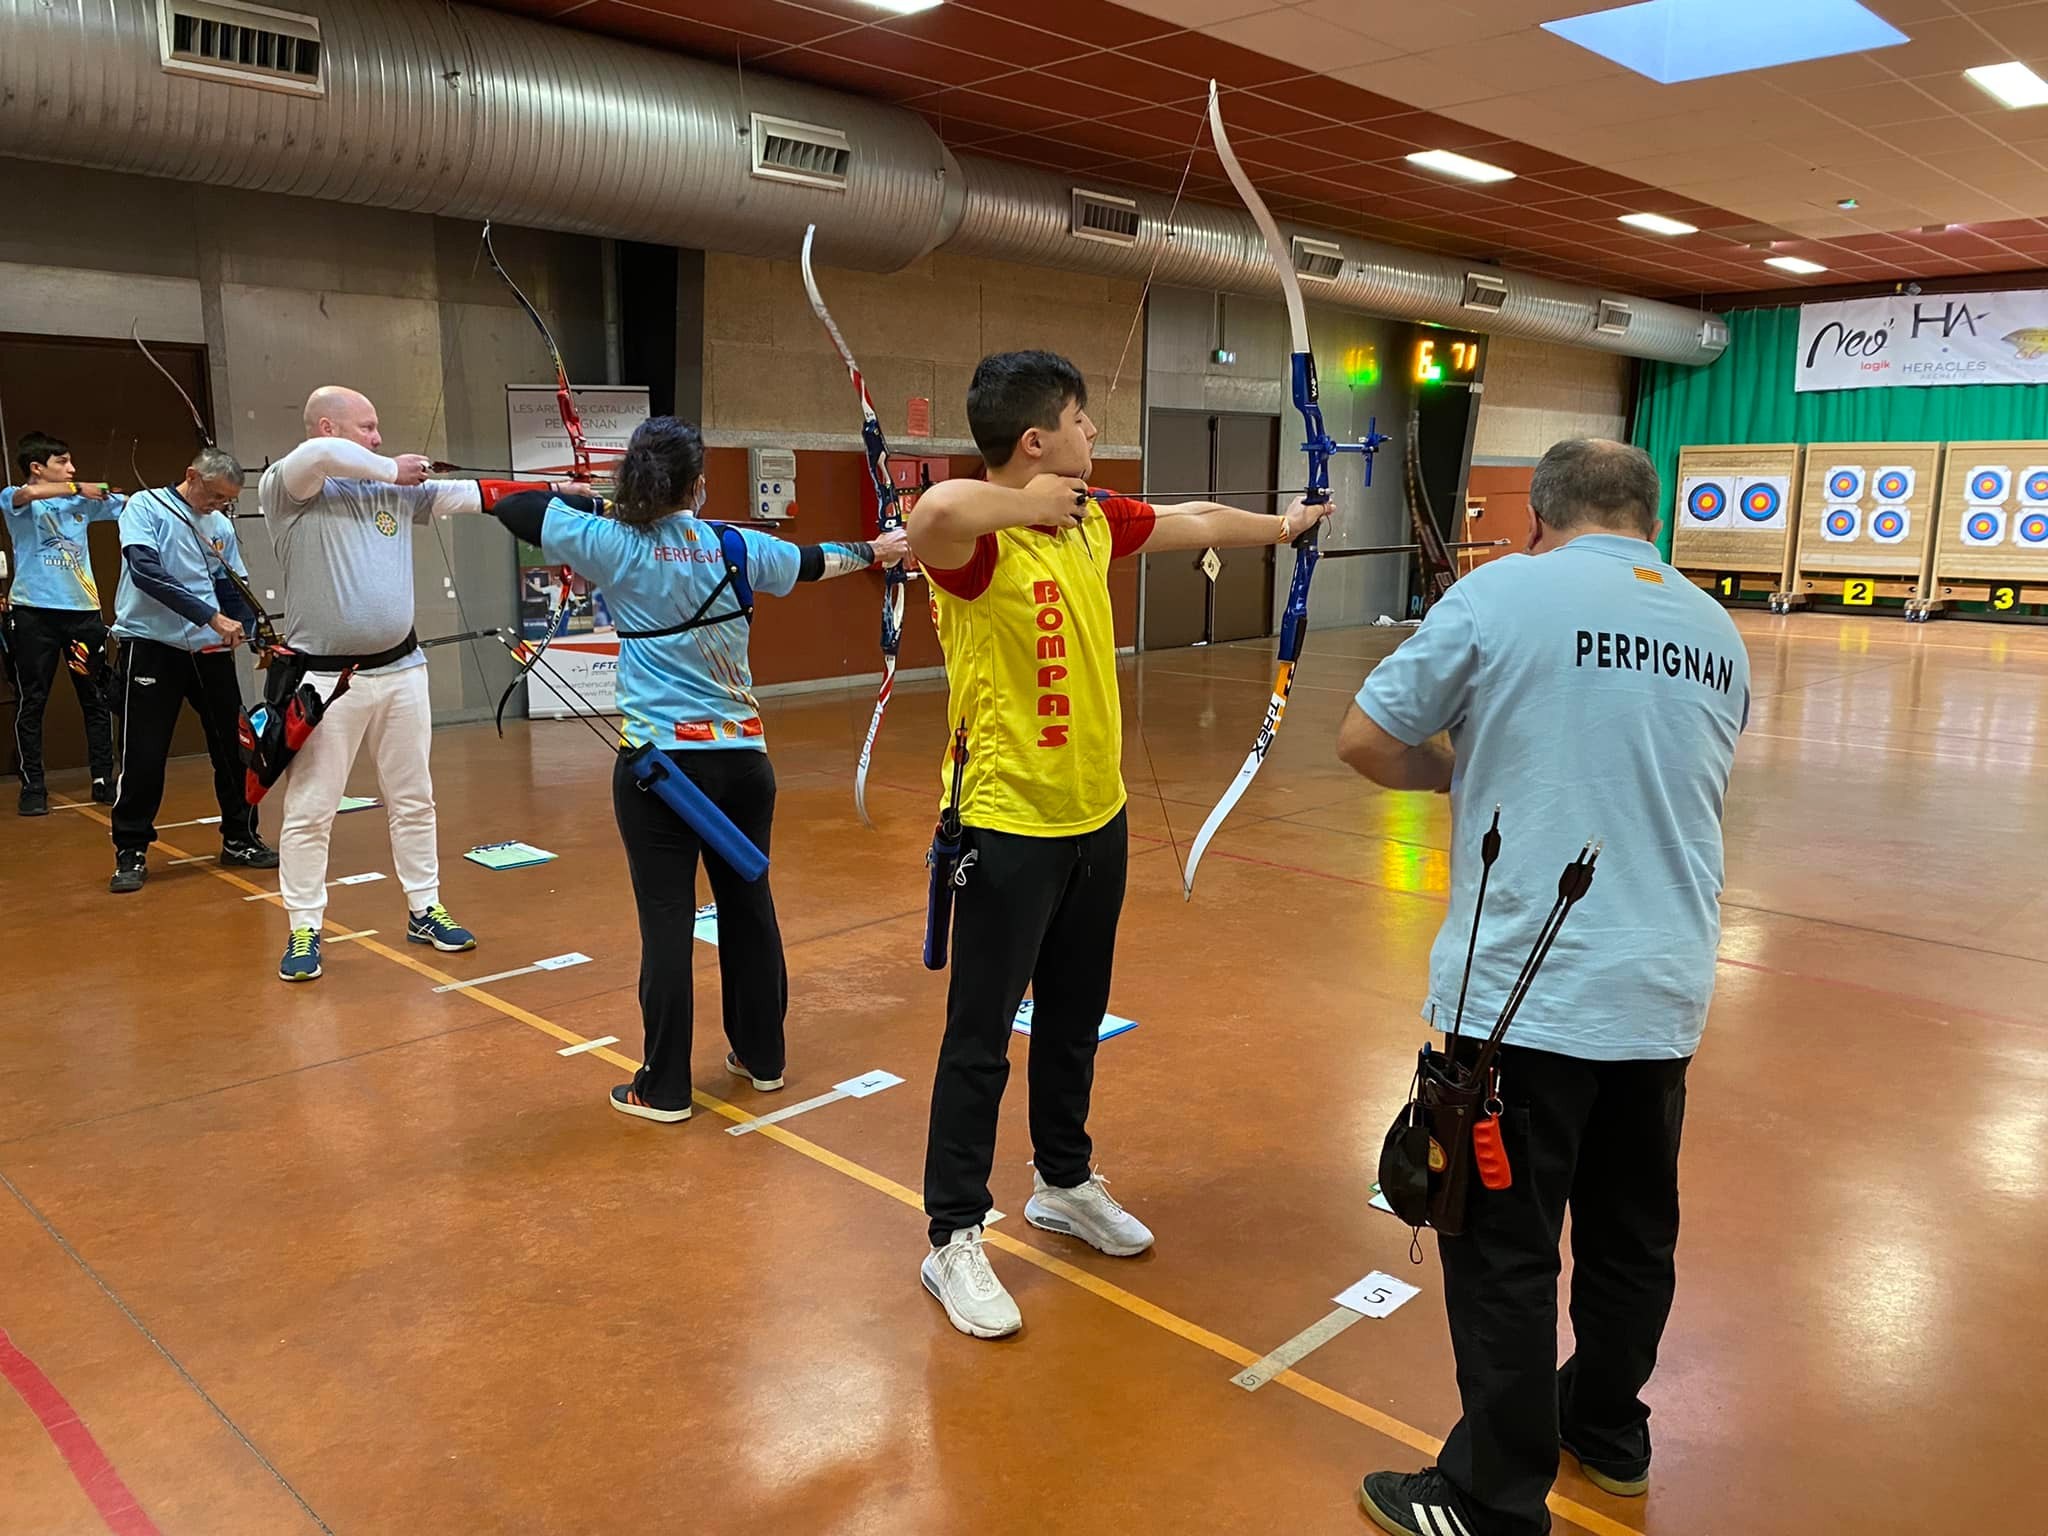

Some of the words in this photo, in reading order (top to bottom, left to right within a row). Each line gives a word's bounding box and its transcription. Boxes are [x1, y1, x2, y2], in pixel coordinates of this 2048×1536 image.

[1860, 359, 1891, 372] logik
[1902, 360, 1987, 374] HERACLES
[513, 404, 533, 414] LES
[590, 404, 647, 415] CATALANS
[1720, 577, 1733, 596] 1
[1851, 583, 1867, 602] 2
[1994, 588, 2014, 610] 3
[1033, 580, 1070, 748] BOMPAS
[1576, 630, 1733, 695] PERPIGNAN
[1363, 1287, 1392, 1304] 5
[1240, 1374, 1261, 1387] 5
